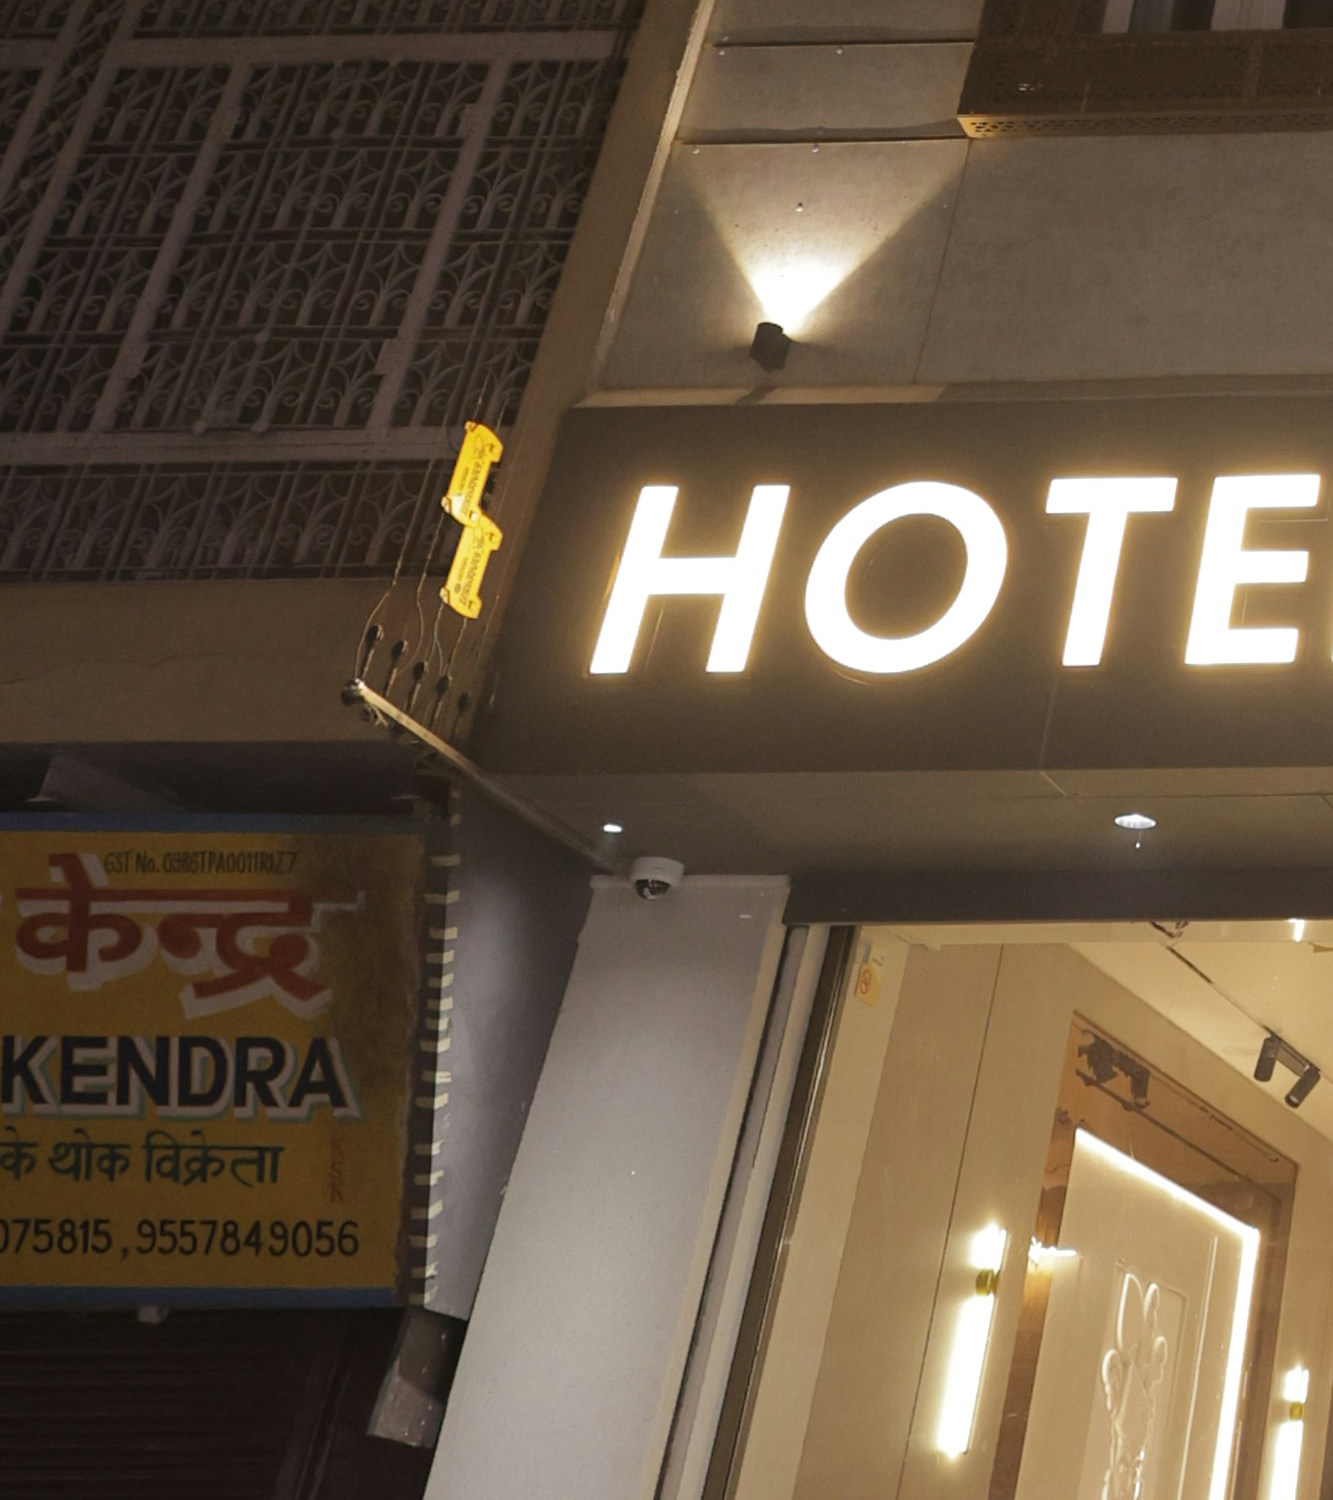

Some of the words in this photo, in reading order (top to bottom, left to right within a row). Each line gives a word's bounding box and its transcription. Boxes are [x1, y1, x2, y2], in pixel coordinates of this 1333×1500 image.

[103, 850, 131, 874] GST
[136, 850, 160, 874] No.
[15, 853, 333, 1002] केन्द्र
[1, 1035, 349, 1108] KENDRA
[0, 1125, 37, 1181] के
[49, 1127, 131, 1182] थोक
[143, 1129, 285, 1188] विक्रेता
